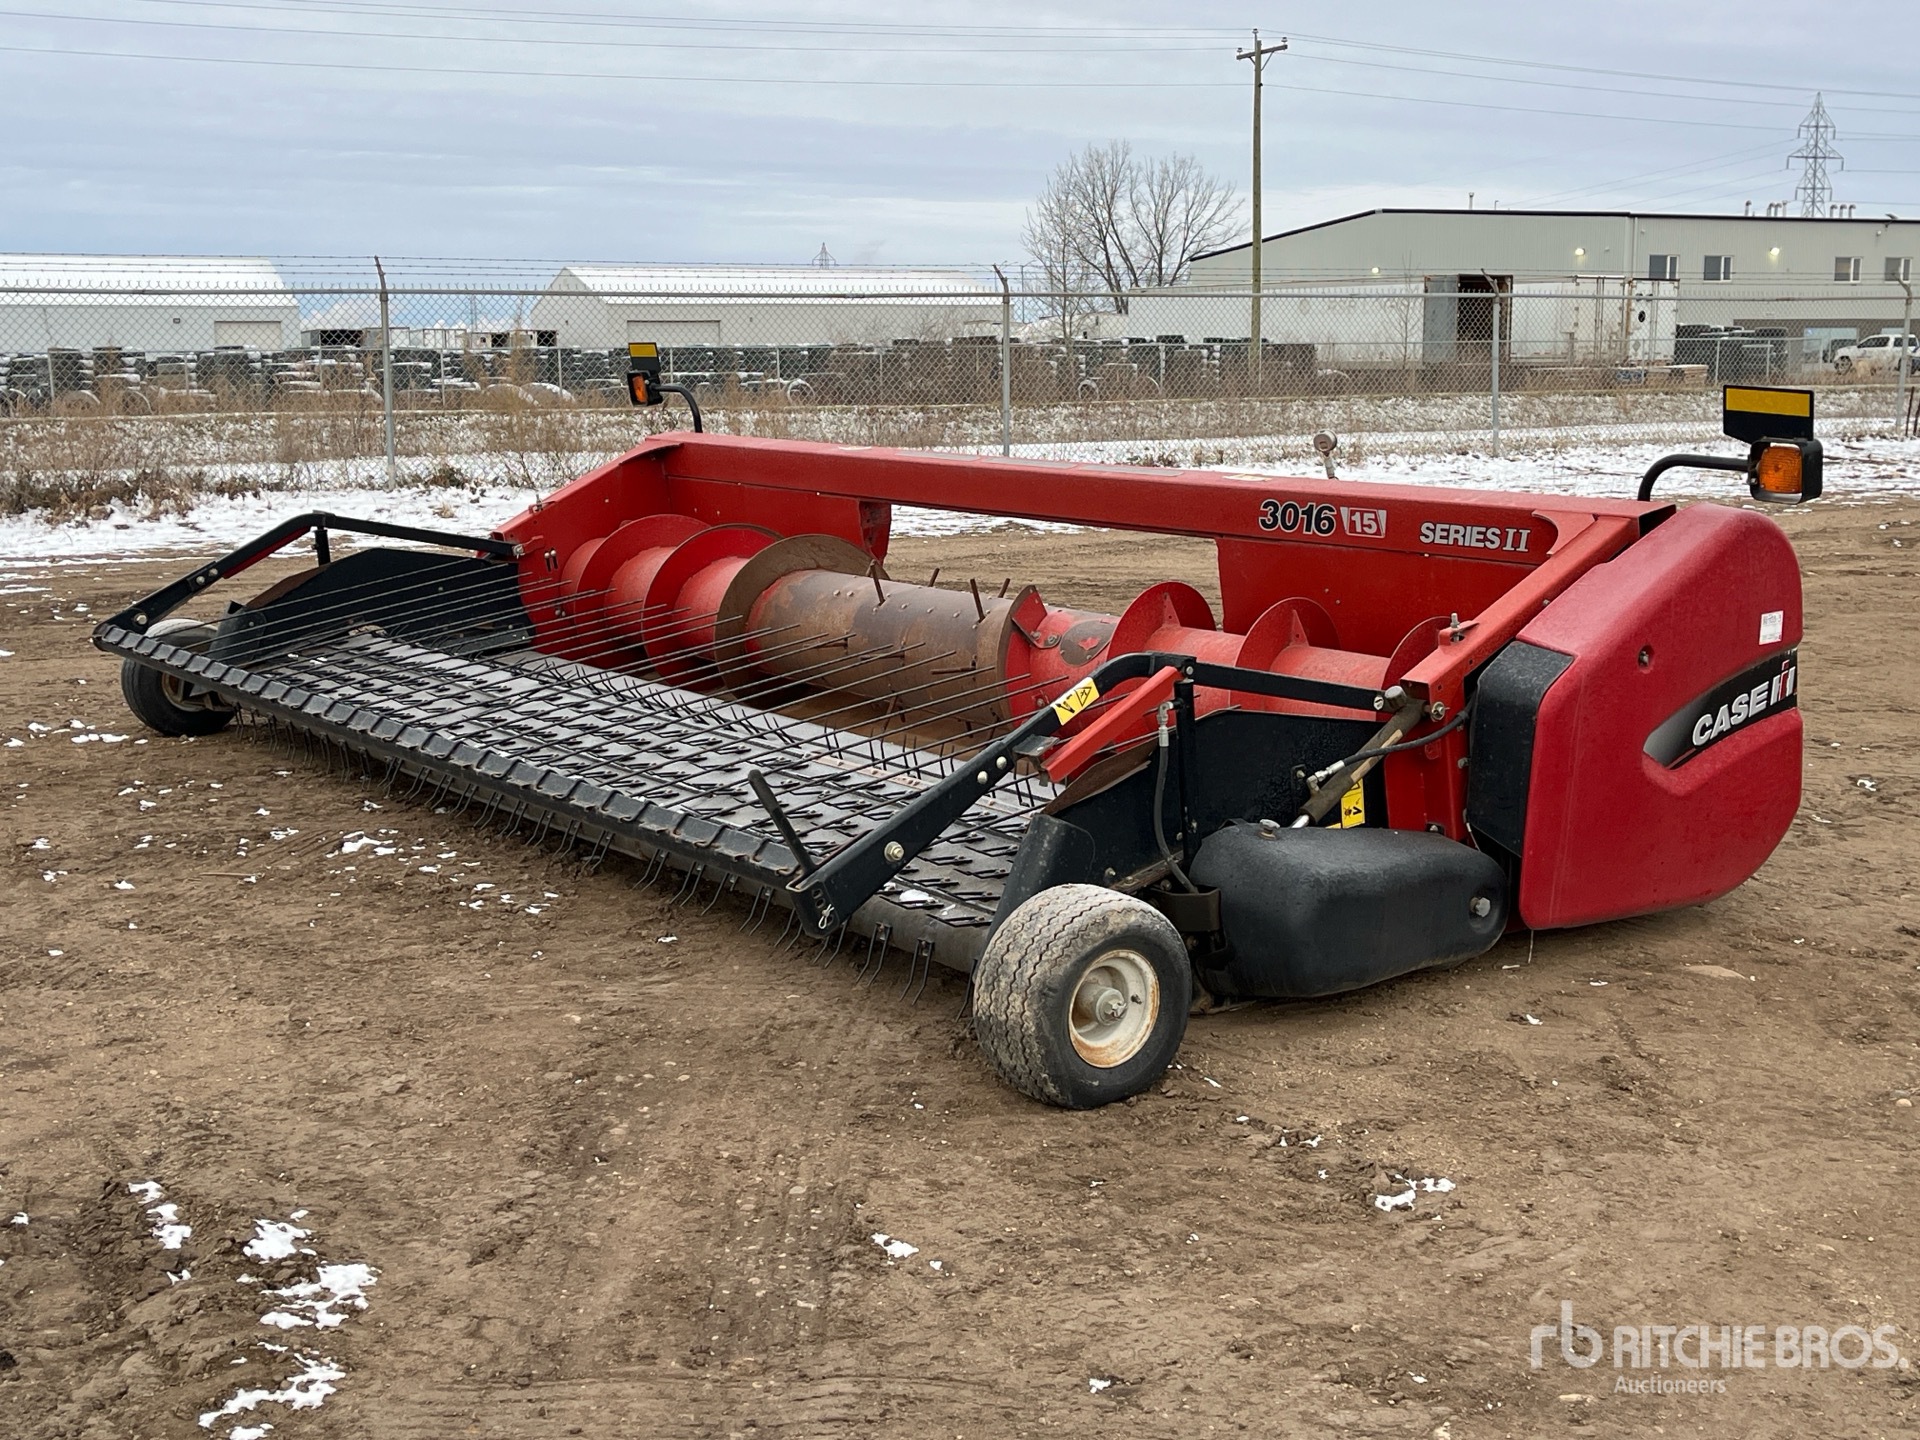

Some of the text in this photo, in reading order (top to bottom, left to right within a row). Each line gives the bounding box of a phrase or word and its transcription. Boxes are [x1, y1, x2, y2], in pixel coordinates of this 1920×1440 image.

[1258, 498, 1531, 552] 3016 15 SERIES II
[1692, 681, 1769, 746] CASE
